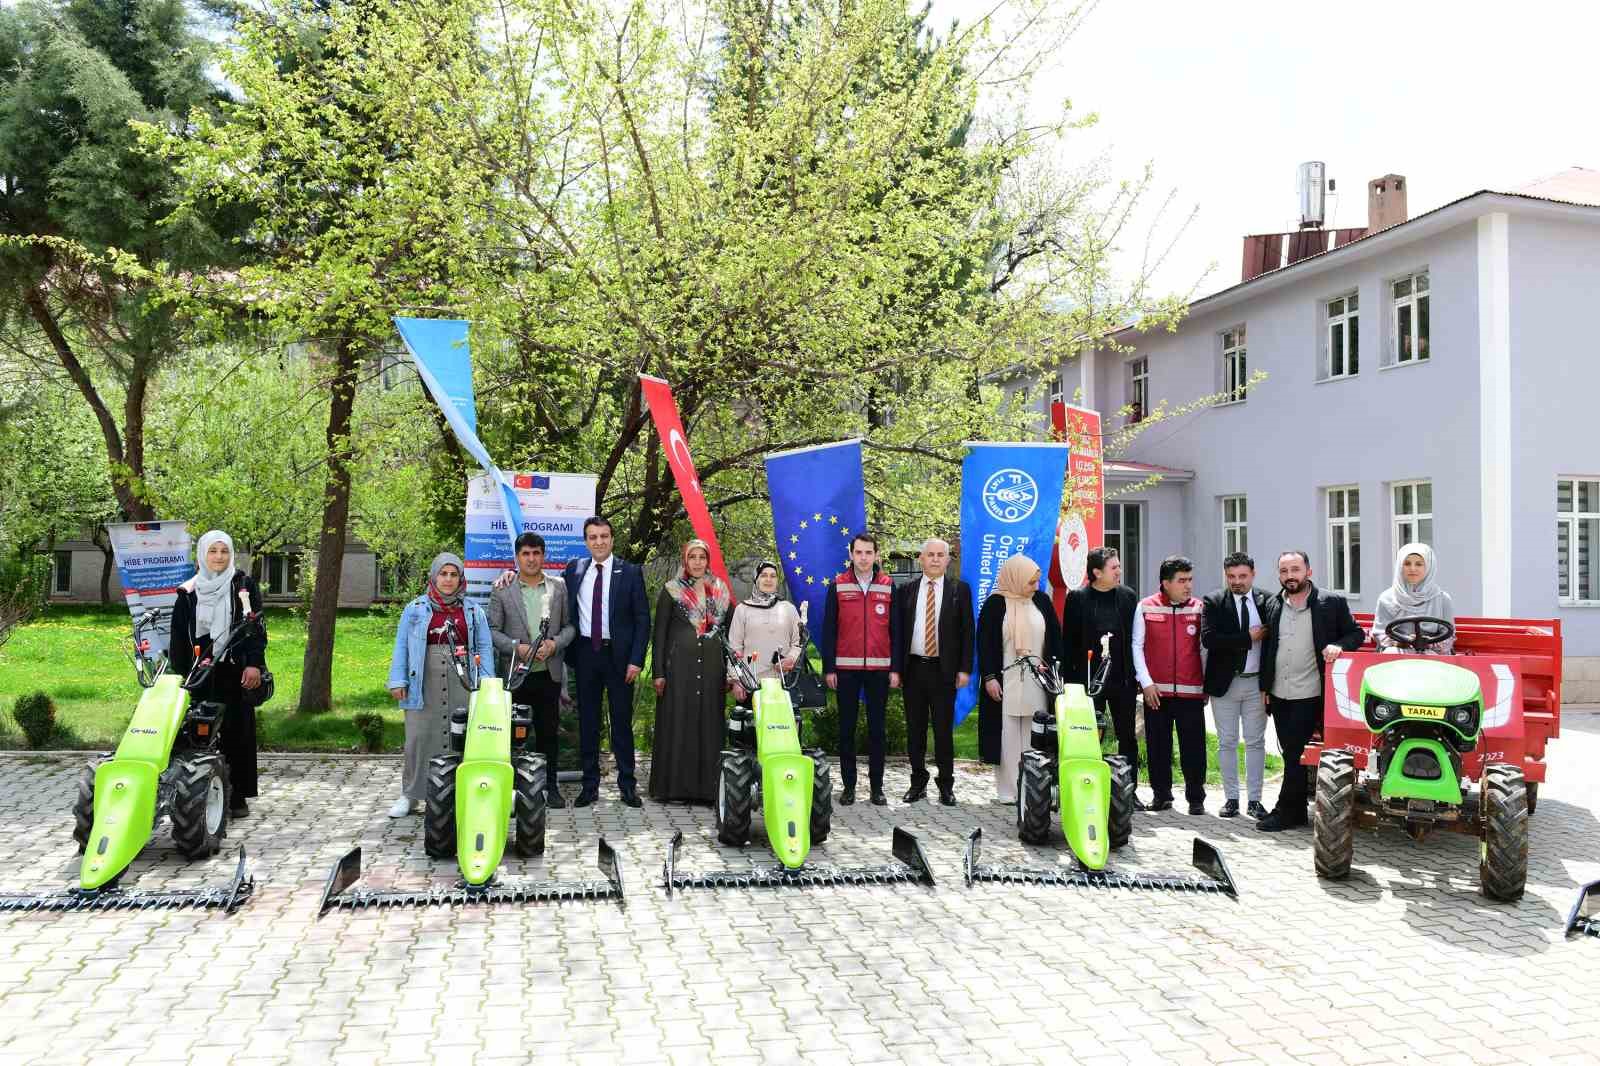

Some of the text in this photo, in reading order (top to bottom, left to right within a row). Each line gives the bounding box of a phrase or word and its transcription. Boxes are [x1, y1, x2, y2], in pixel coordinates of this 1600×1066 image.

[491, 520, 573, 532] HİB ROGRAMI
[1016, 536, 1029, 554] Fo
[977, 534, 995, 613] United Natio
[1407, 707, 1439, 717] TARAL
